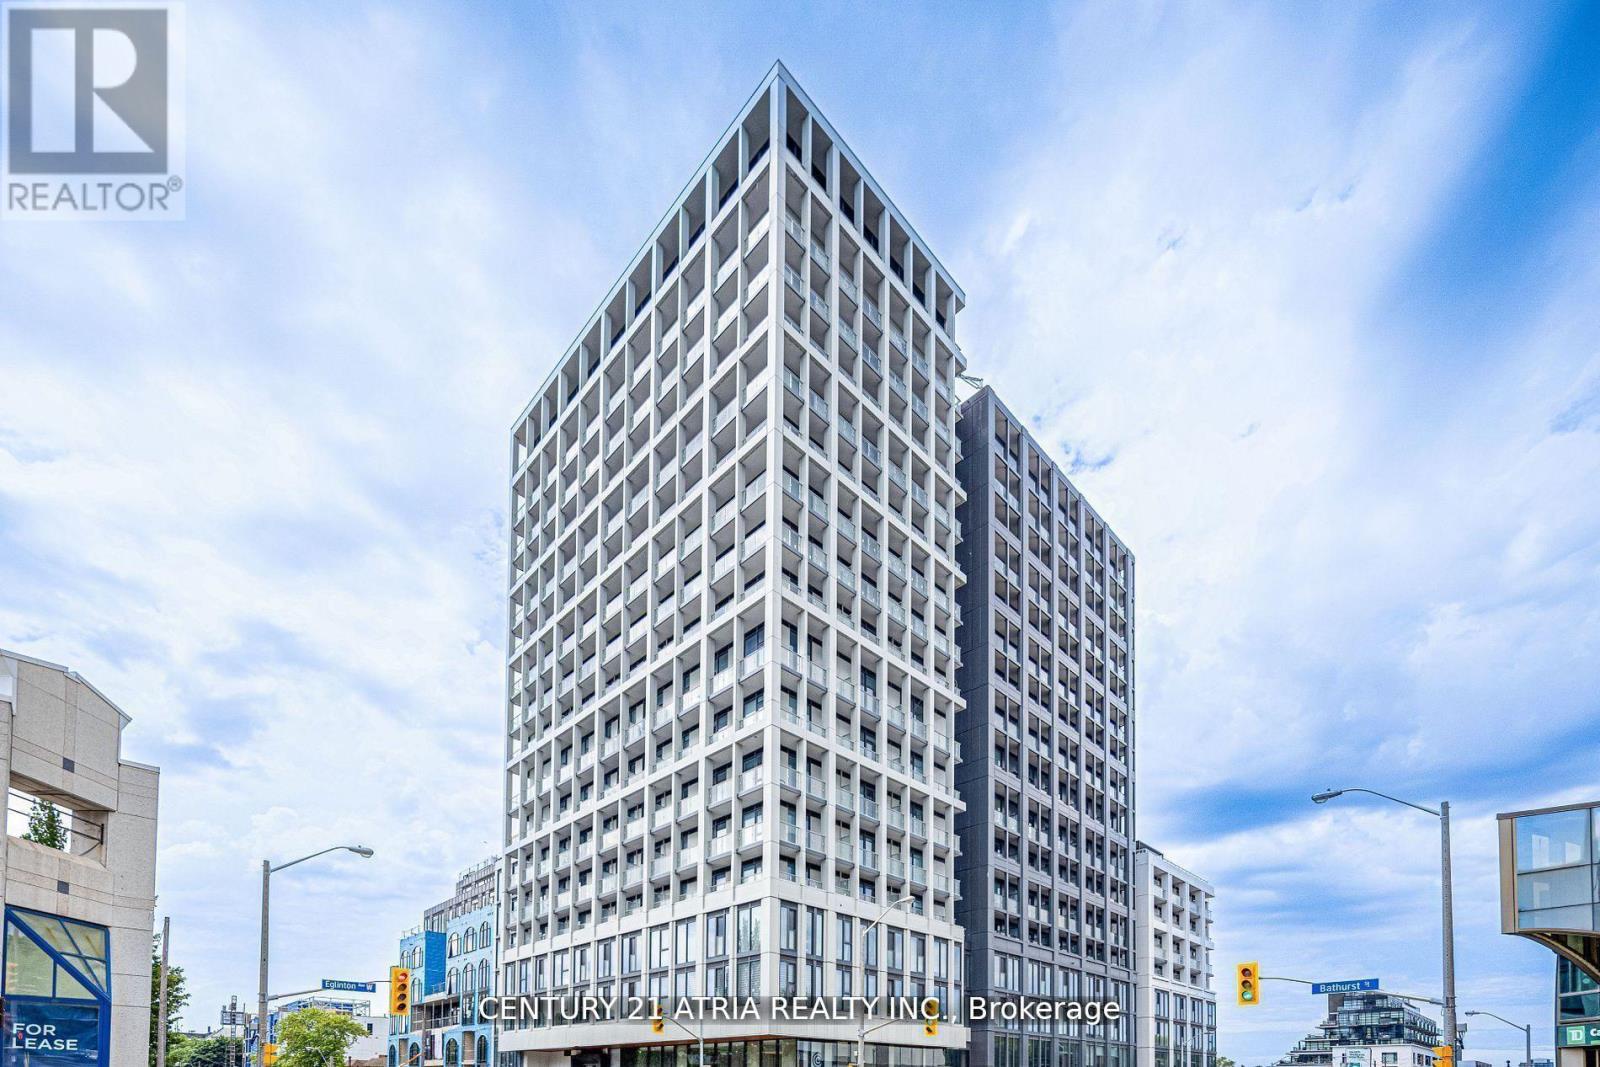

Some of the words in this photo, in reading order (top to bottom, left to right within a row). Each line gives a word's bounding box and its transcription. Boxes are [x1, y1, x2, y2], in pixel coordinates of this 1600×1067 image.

[325, 980, 356, 990] Eglinton
[1320, 982, 1360, 993] Bathurst
[12, 1023, 56, 1036] FOR
[1569, 1029, 1583, 1041] TD
[12, 1037, 78, 1050] LEASE
